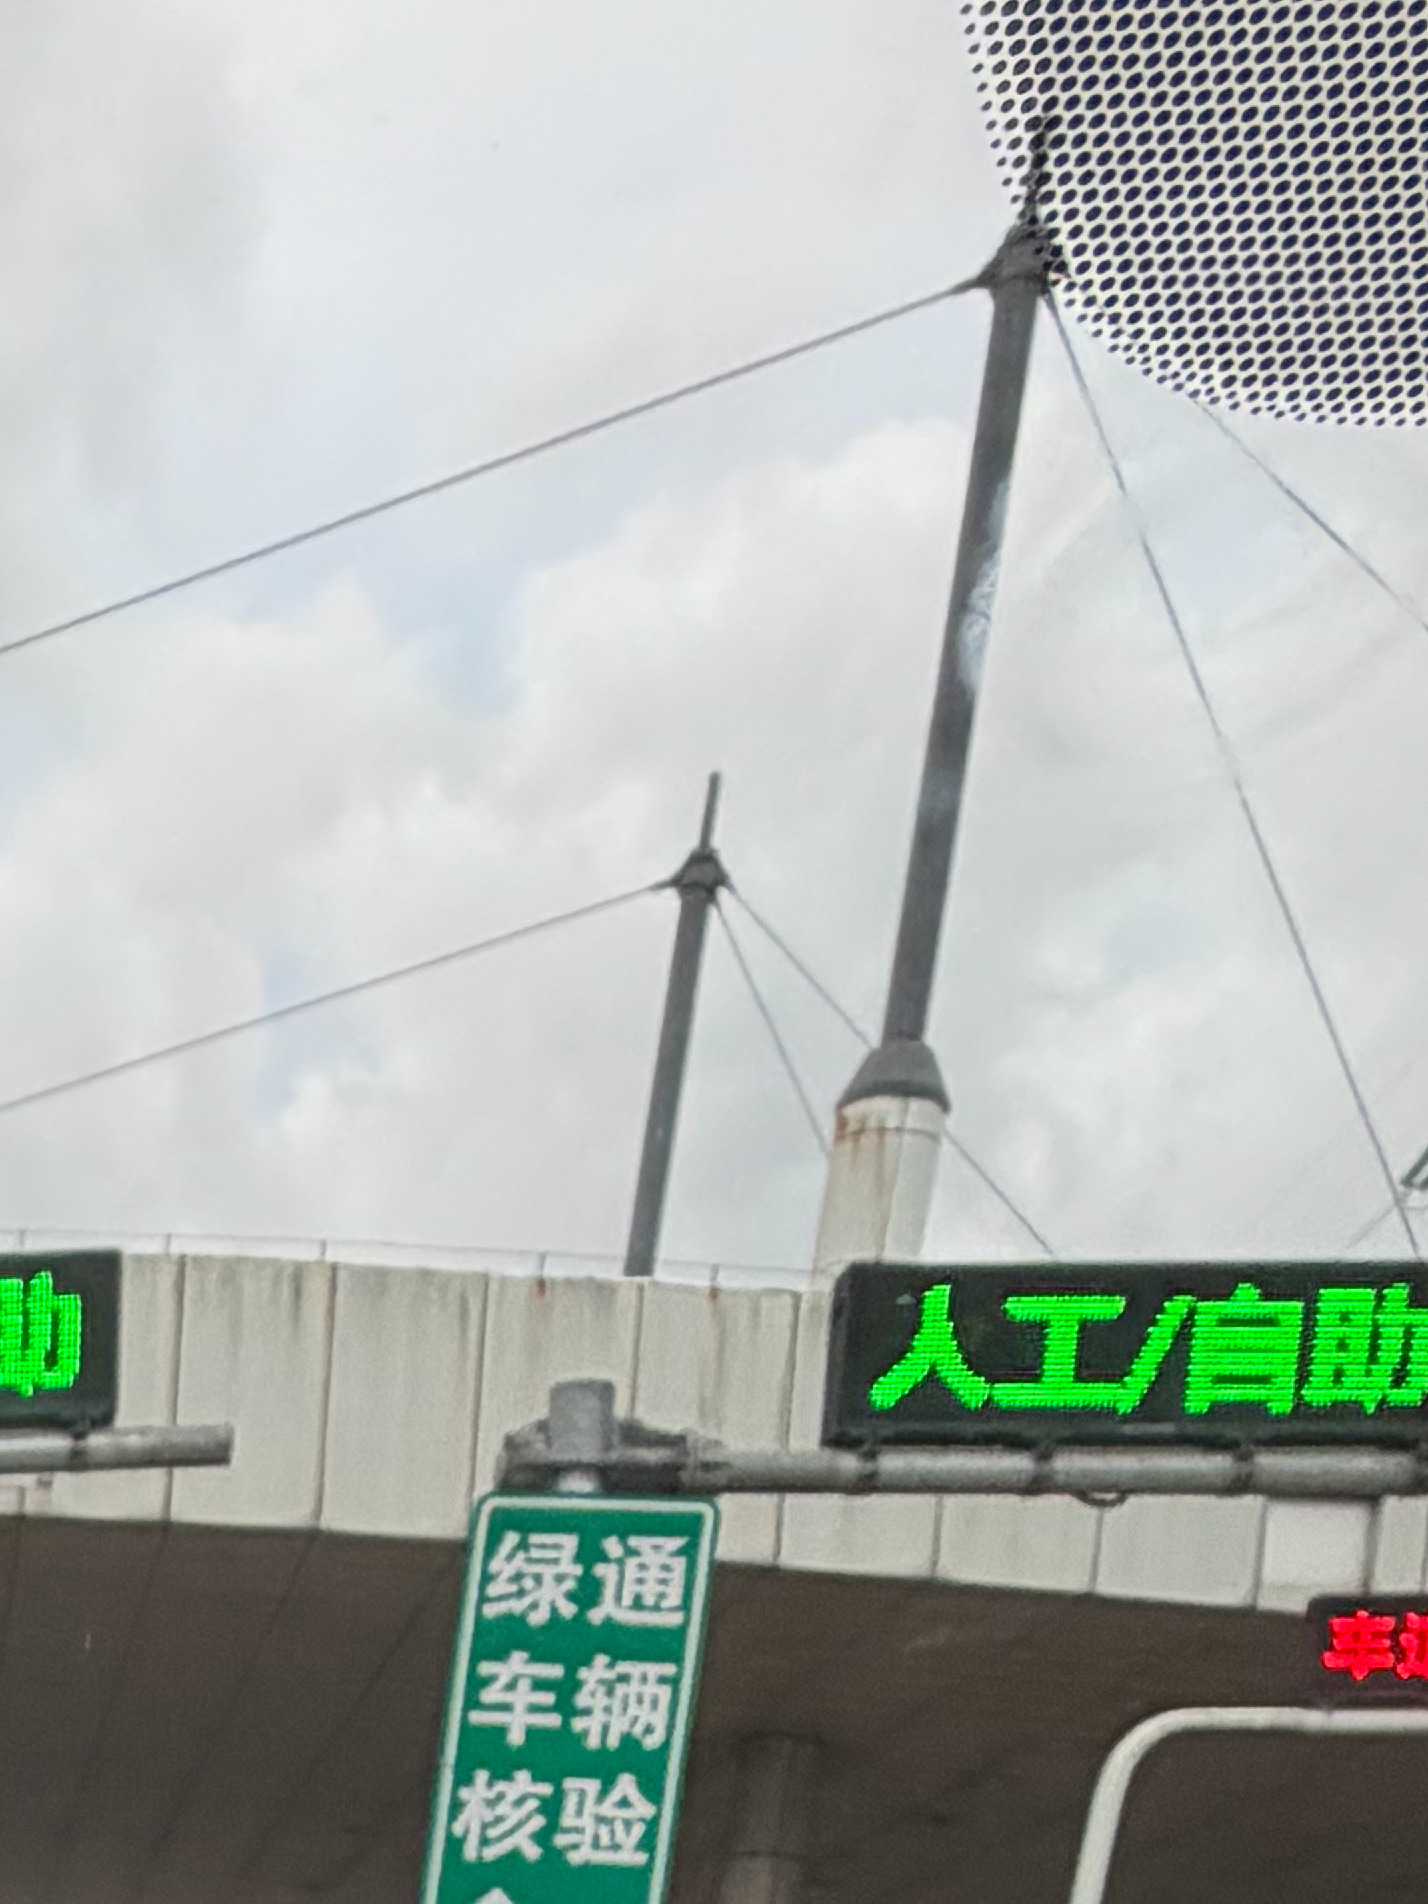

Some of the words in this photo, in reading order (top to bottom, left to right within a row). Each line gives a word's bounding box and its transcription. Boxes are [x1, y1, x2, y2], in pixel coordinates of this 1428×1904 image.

[867, 1282, 1428, 1417] 人工/自助
[481, 1530, 691, 1629] 绿通
[467, 1650, 678, 1751] 车辆
[450, 1769, 658, 1868] 核验
